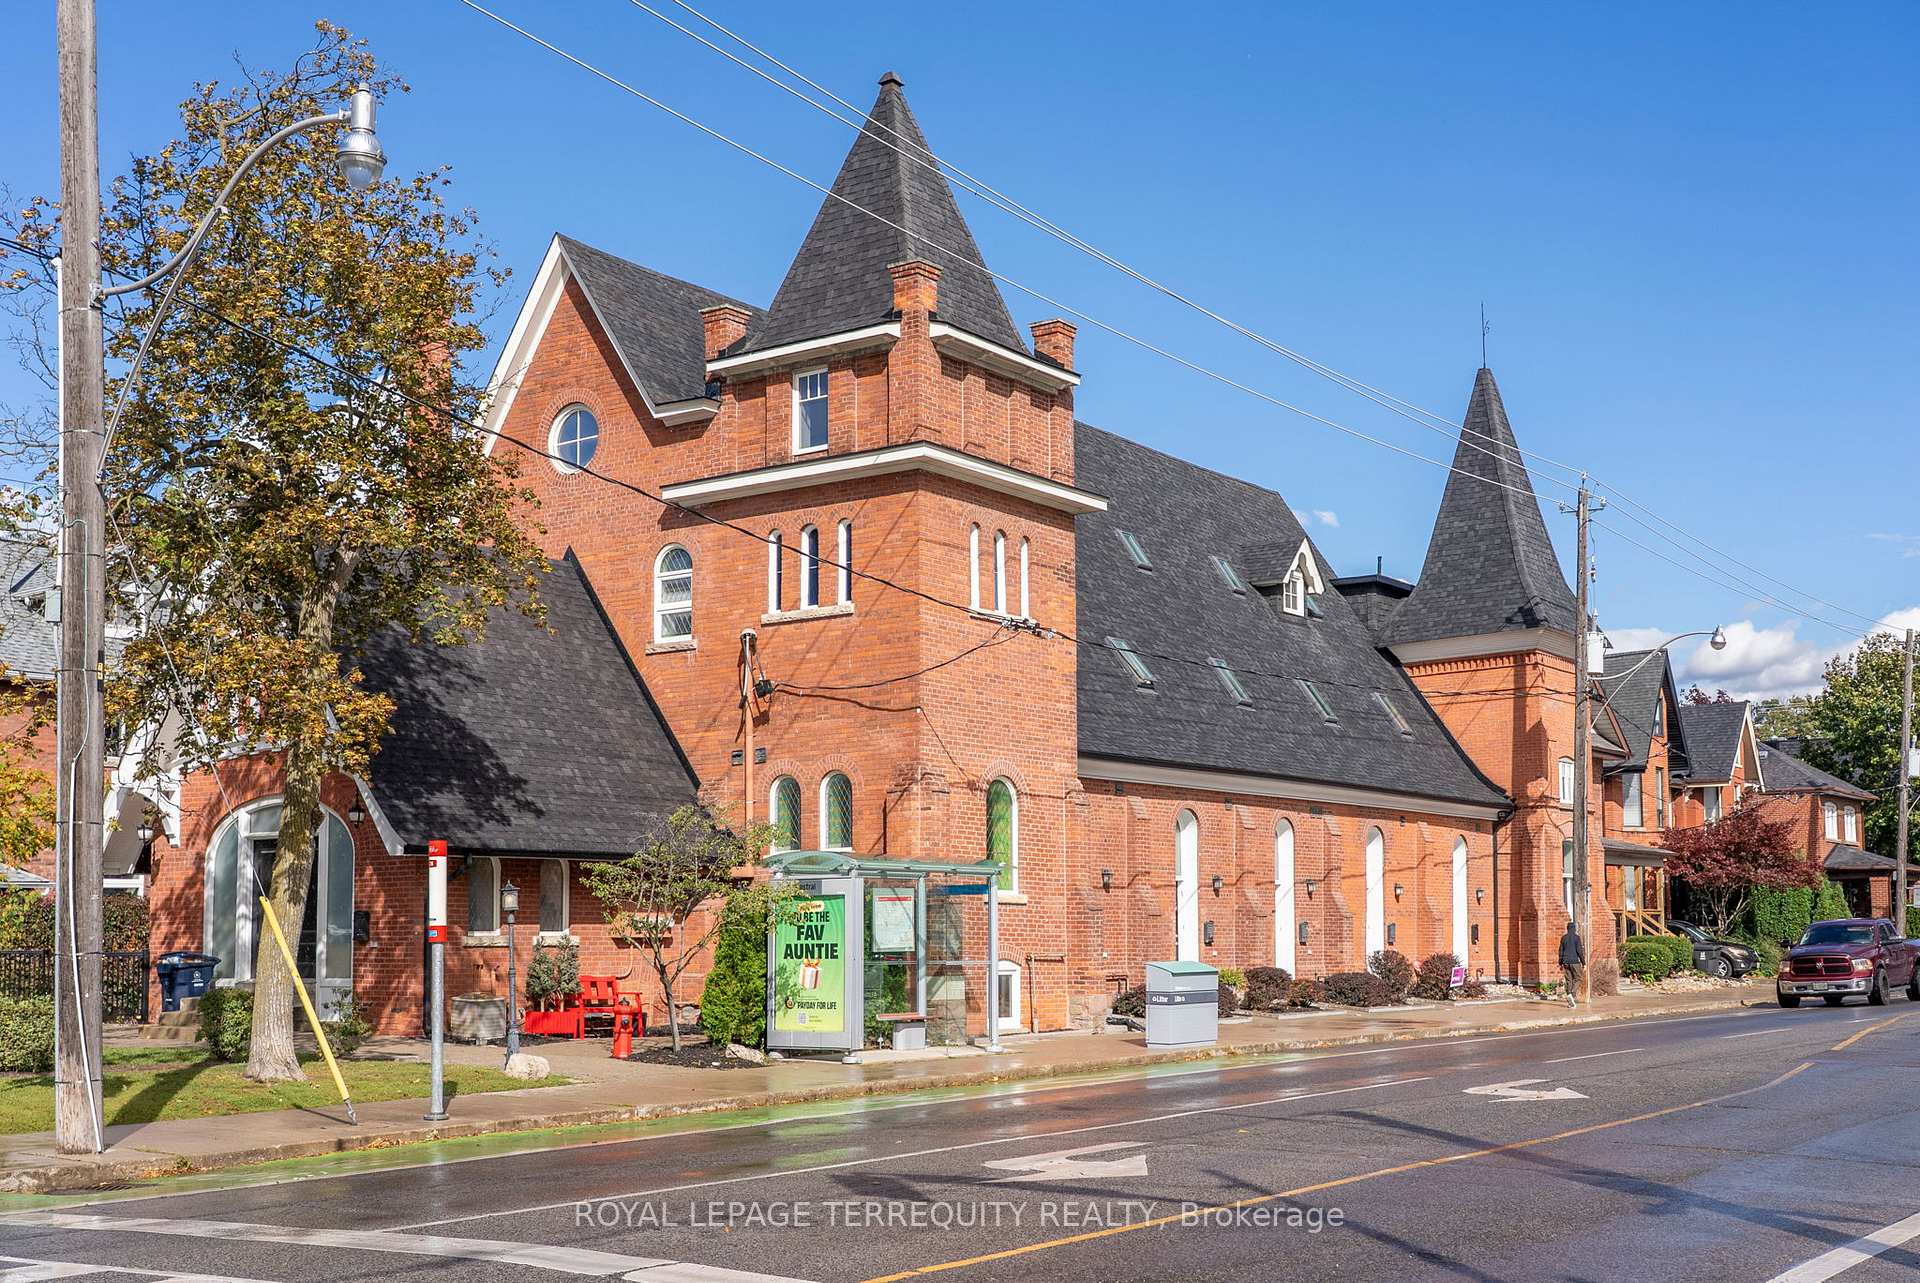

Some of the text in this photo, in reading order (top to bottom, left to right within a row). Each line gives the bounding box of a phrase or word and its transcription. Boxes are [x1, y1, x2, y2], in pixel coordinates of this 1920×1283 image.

[804, 912, 813, 922] BE
[816, 912, 829, 922] THE
[797, 925, 824, 940] FAV
[784, 944, 838, 959] AUNTIE
